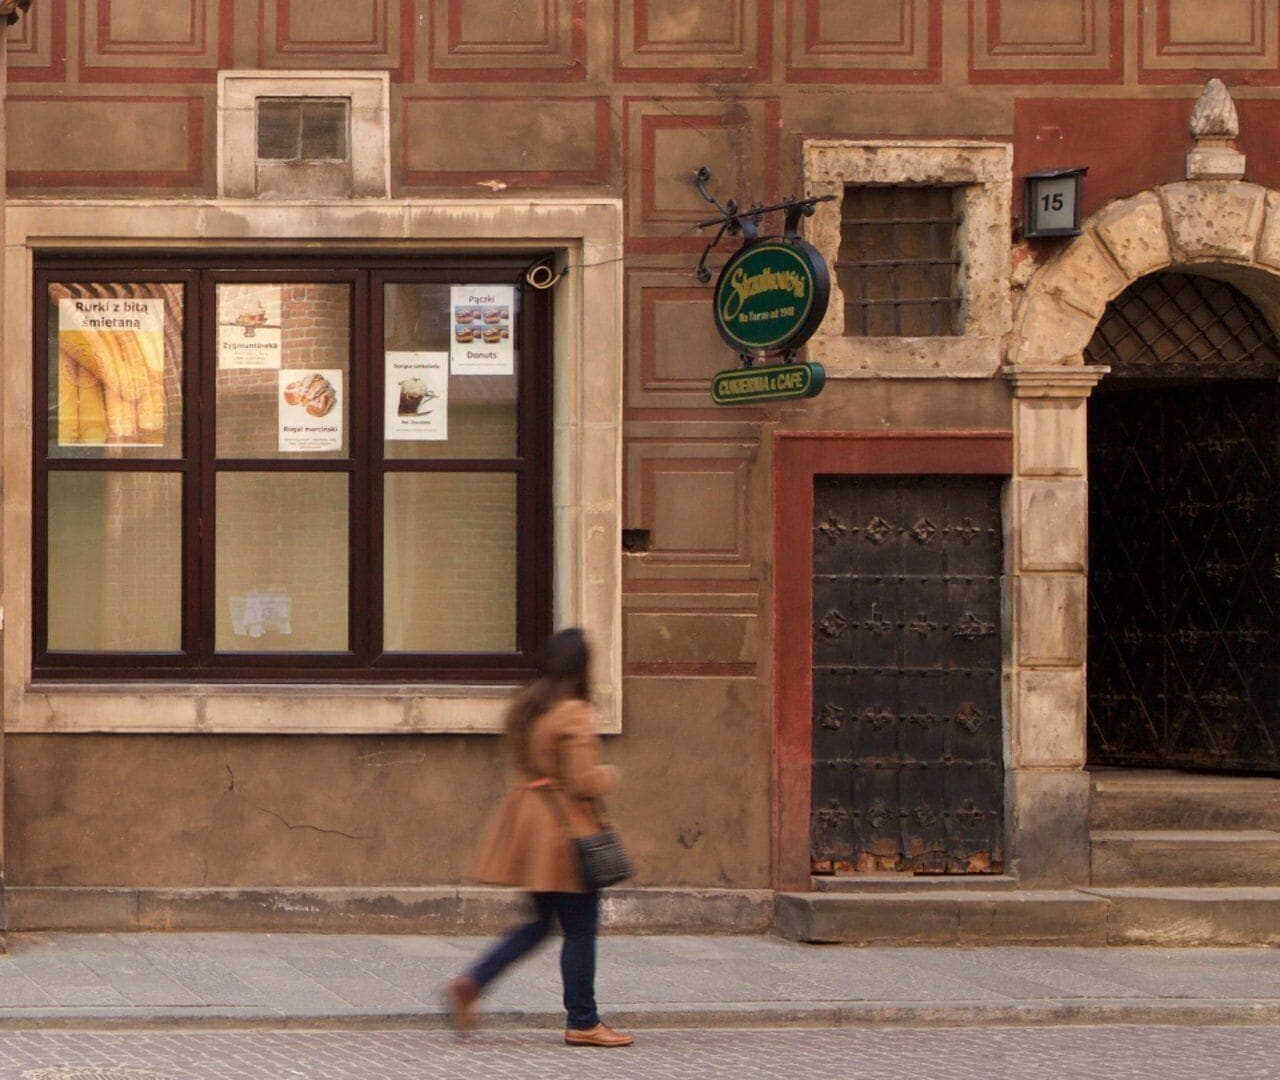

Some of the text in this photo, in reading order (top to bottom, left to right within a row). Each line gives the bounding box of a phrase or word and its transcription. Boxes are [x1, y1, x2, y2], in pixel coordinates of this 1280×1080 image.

[1041, 193, 1064, 211] 15
[468, 295, 496, 305] Pączki
[75, 301, 149, 315] Rurki z bitą
[82, 315, 141, 329] śmietaną
[466, 351, 497, 360] Donuts
